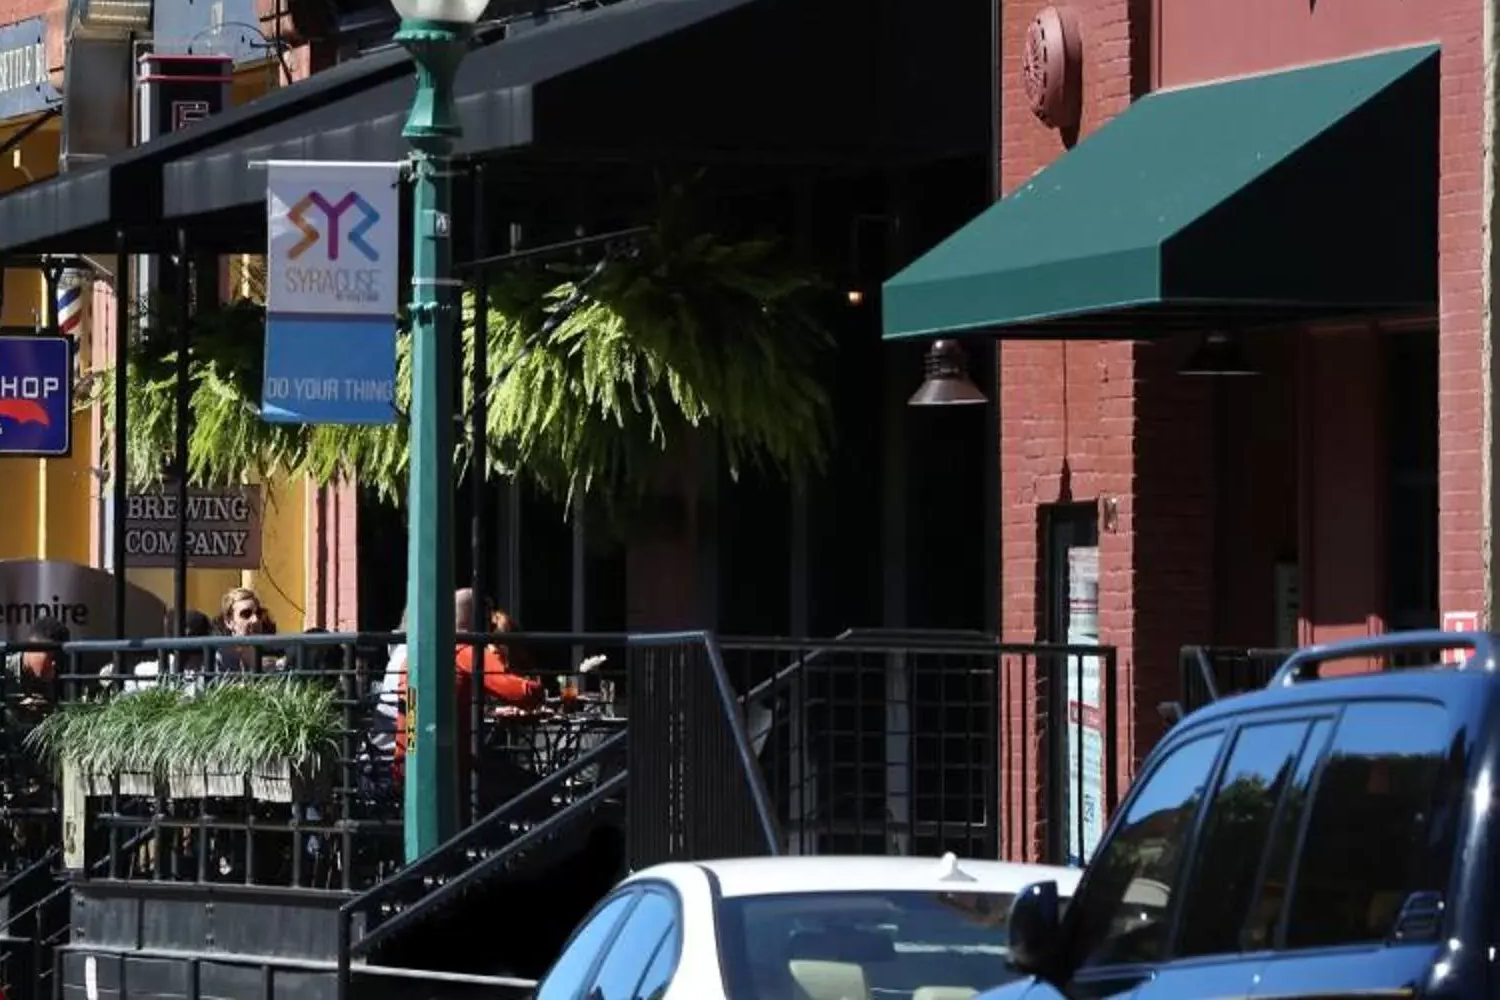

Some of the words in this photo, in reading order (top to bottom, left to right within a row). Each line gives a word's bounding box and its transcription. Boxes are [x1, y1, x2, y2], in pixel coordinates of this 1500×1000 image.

[285, 268, 381, 295] SYRACUSE
[267, 376, 289, 400] DO
[293, 377, 339, 400] YOUR
[345, 377, 393, 402] THING
[127, 495, 249, 521] BREWING
[126, 529, 247, 556] COMPANY
